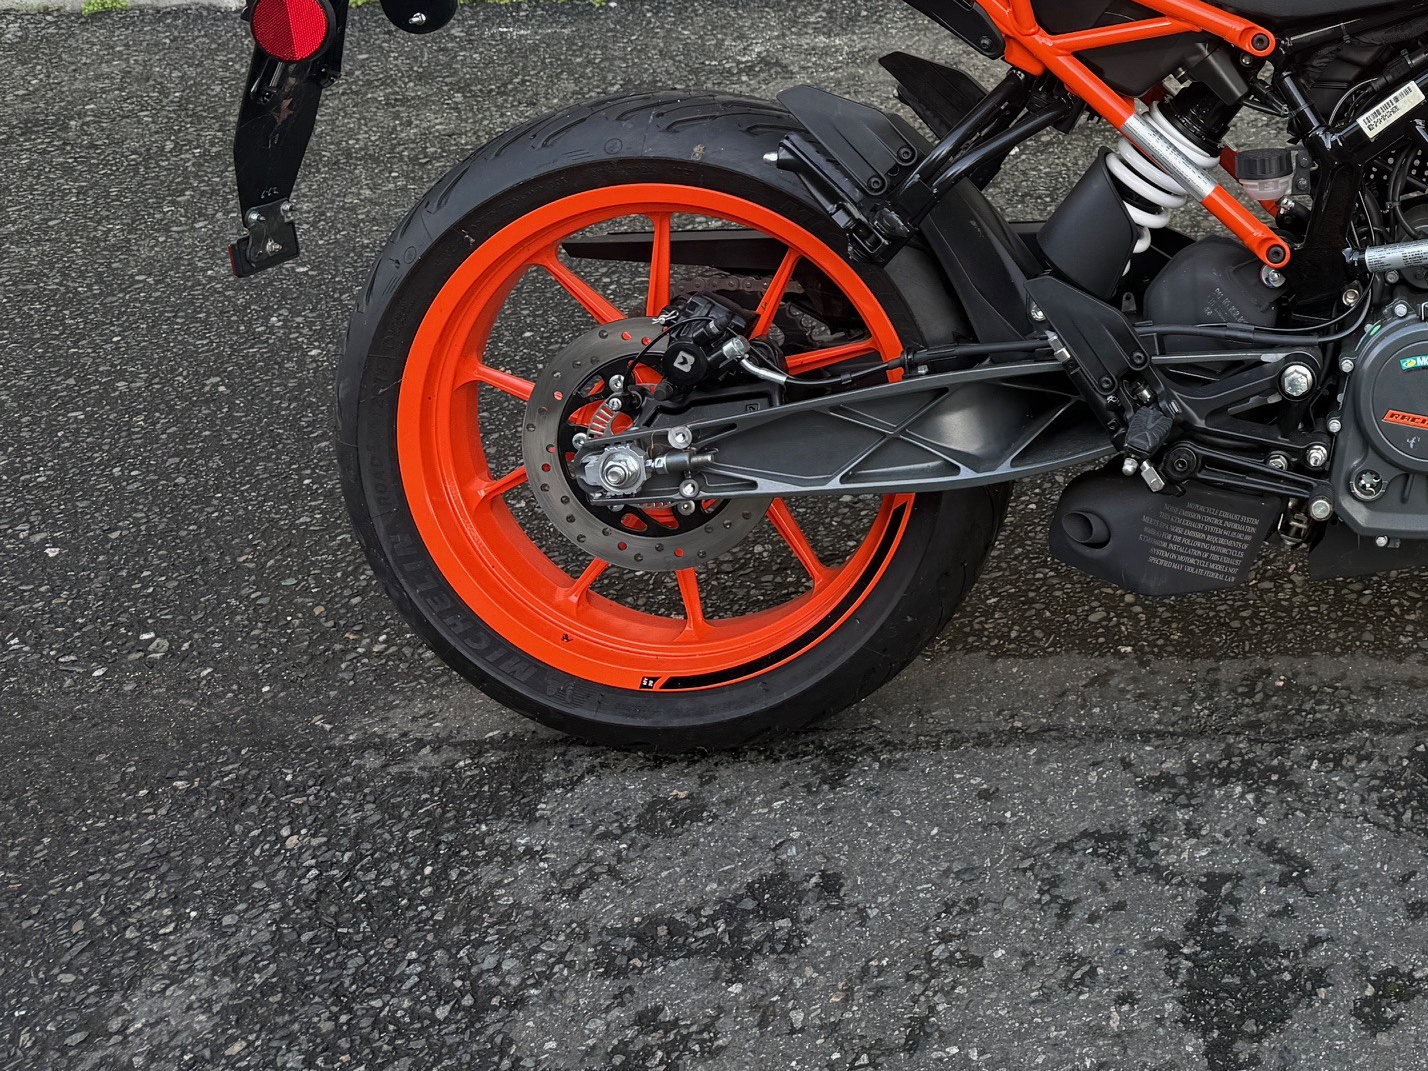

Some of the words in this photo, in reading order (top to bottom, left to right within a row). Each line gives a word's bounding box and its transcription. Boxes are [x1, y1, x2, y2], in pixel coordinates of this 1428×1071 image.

[1159, 511, 1170, 520] THIS
[1170, 515, 1181, 524] KTM
[1182, 518, 1203, 530] EXHAUST
[1204, 524, 1223, 535] SYSTEM
[1178, 508, 1201, 520] EMISSION
[1201, 514, 1223, 526] CONTROL
[1186, 502, 1218, 516] MOTORCYCLE
[1218, 510, 1240, 521] EXHAUST
[1240, 515, 1259, 526] SYSTEM
[1142, 515, 1159, 526] MEETS
[1169, 525, 1183, 534] NOISE
[1184, 528, 1205, 540] EMISSION
[1206, 534, 1240, 549] REQUIREMENTS
[1161, 531, 1171, 540] FOR
[1181, 537, 1209, 550] FOLLOWING
[1149, 547, 1169, 558] SYSTEM
[1169, 552, 1177, 560] ON
[1177, 554, 1208, 568] MOTORCYCLE
[1208, 562, 1227, 572] MODELS
[1227, 566, 1238, 575] NOT
[1168, 543, 1201, 557] INSTALLATION
[1202, 551, 1209, 559] OF
[1209, 553, 1219, 561] THIS
[1219, 556, 1241, 566] EXHAUST
[1148, 556, 1172, 568] SPECIFIED
[1172, 562, 1182, 570] MAY
[1184, 565, 1203, 575] VIOLATE
[1203, 570, 1224, 580] FEDERAL
[389, 529, 538, 689] MICHELIN
